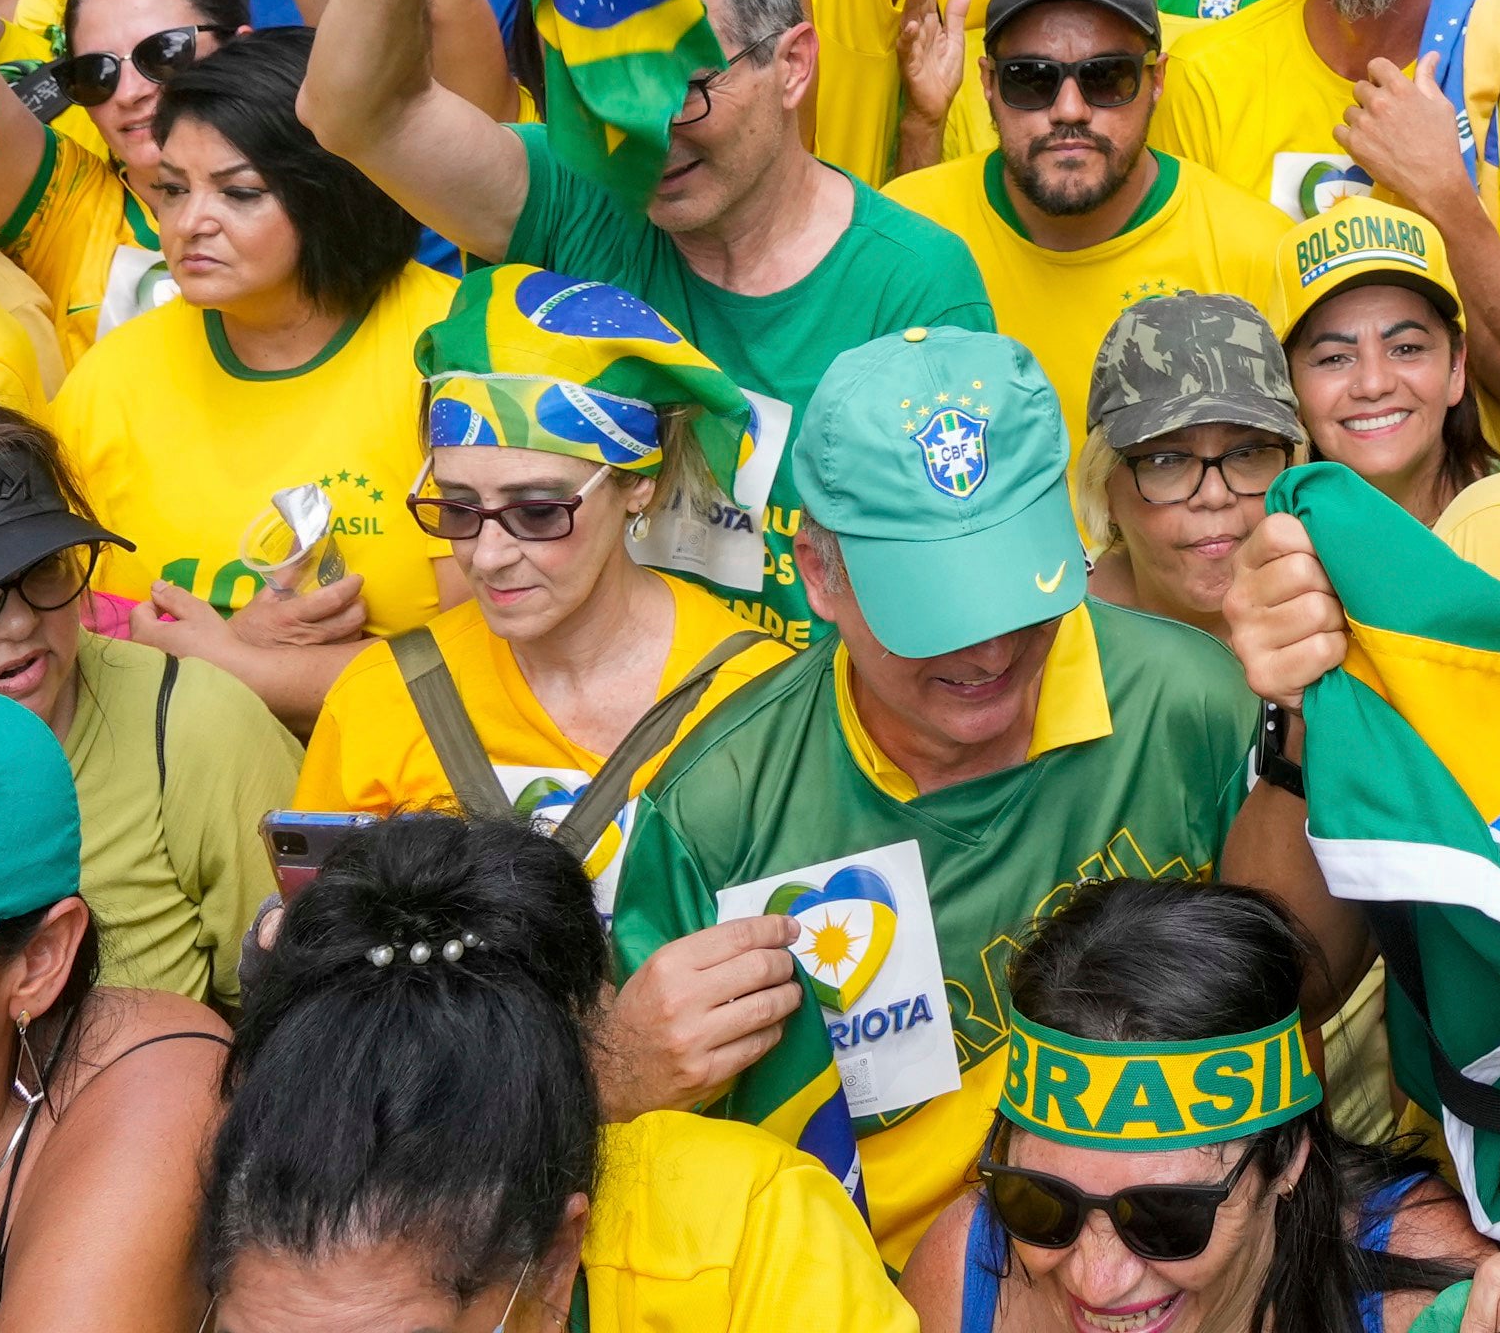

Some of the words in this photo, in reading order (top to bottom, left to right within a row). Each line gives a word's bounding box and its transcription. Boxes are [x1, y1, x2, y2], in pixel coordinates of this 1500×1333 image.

[1295, 215, 1427, 273] BOLSONARO
[940, 443, 969, 462] CBF
[331, 516, 384, 536] ASIL
[827, 993, 934, 1051] RIOTA
[1002, 1028, 1314, 1135] BRASIL
